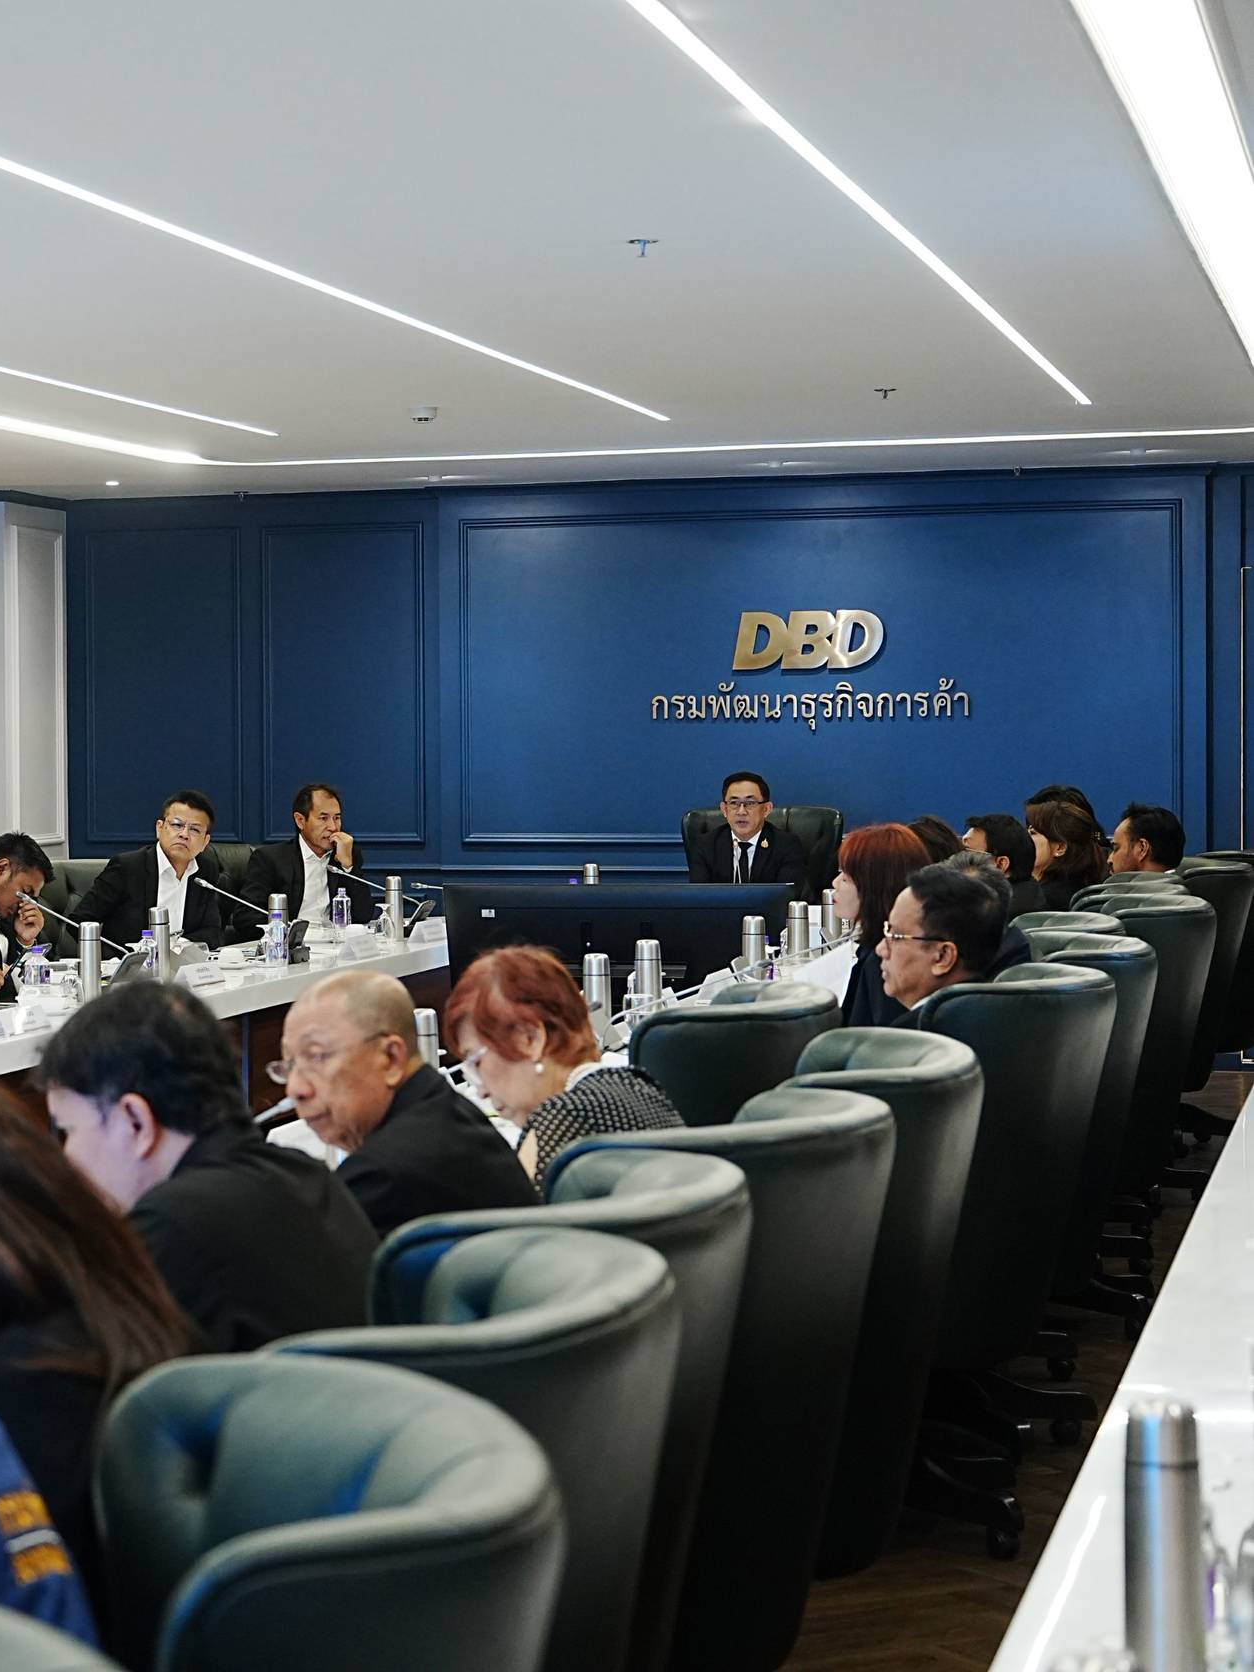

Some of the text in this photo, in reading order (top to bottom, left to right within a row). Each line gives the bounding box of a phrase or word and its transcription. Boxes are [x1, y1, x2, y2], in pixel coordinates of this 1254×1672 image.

[732, 609, 884, 671] DBD
[651, 678, 970, 731] กรมพัฒนาธุรกิจการค้า
